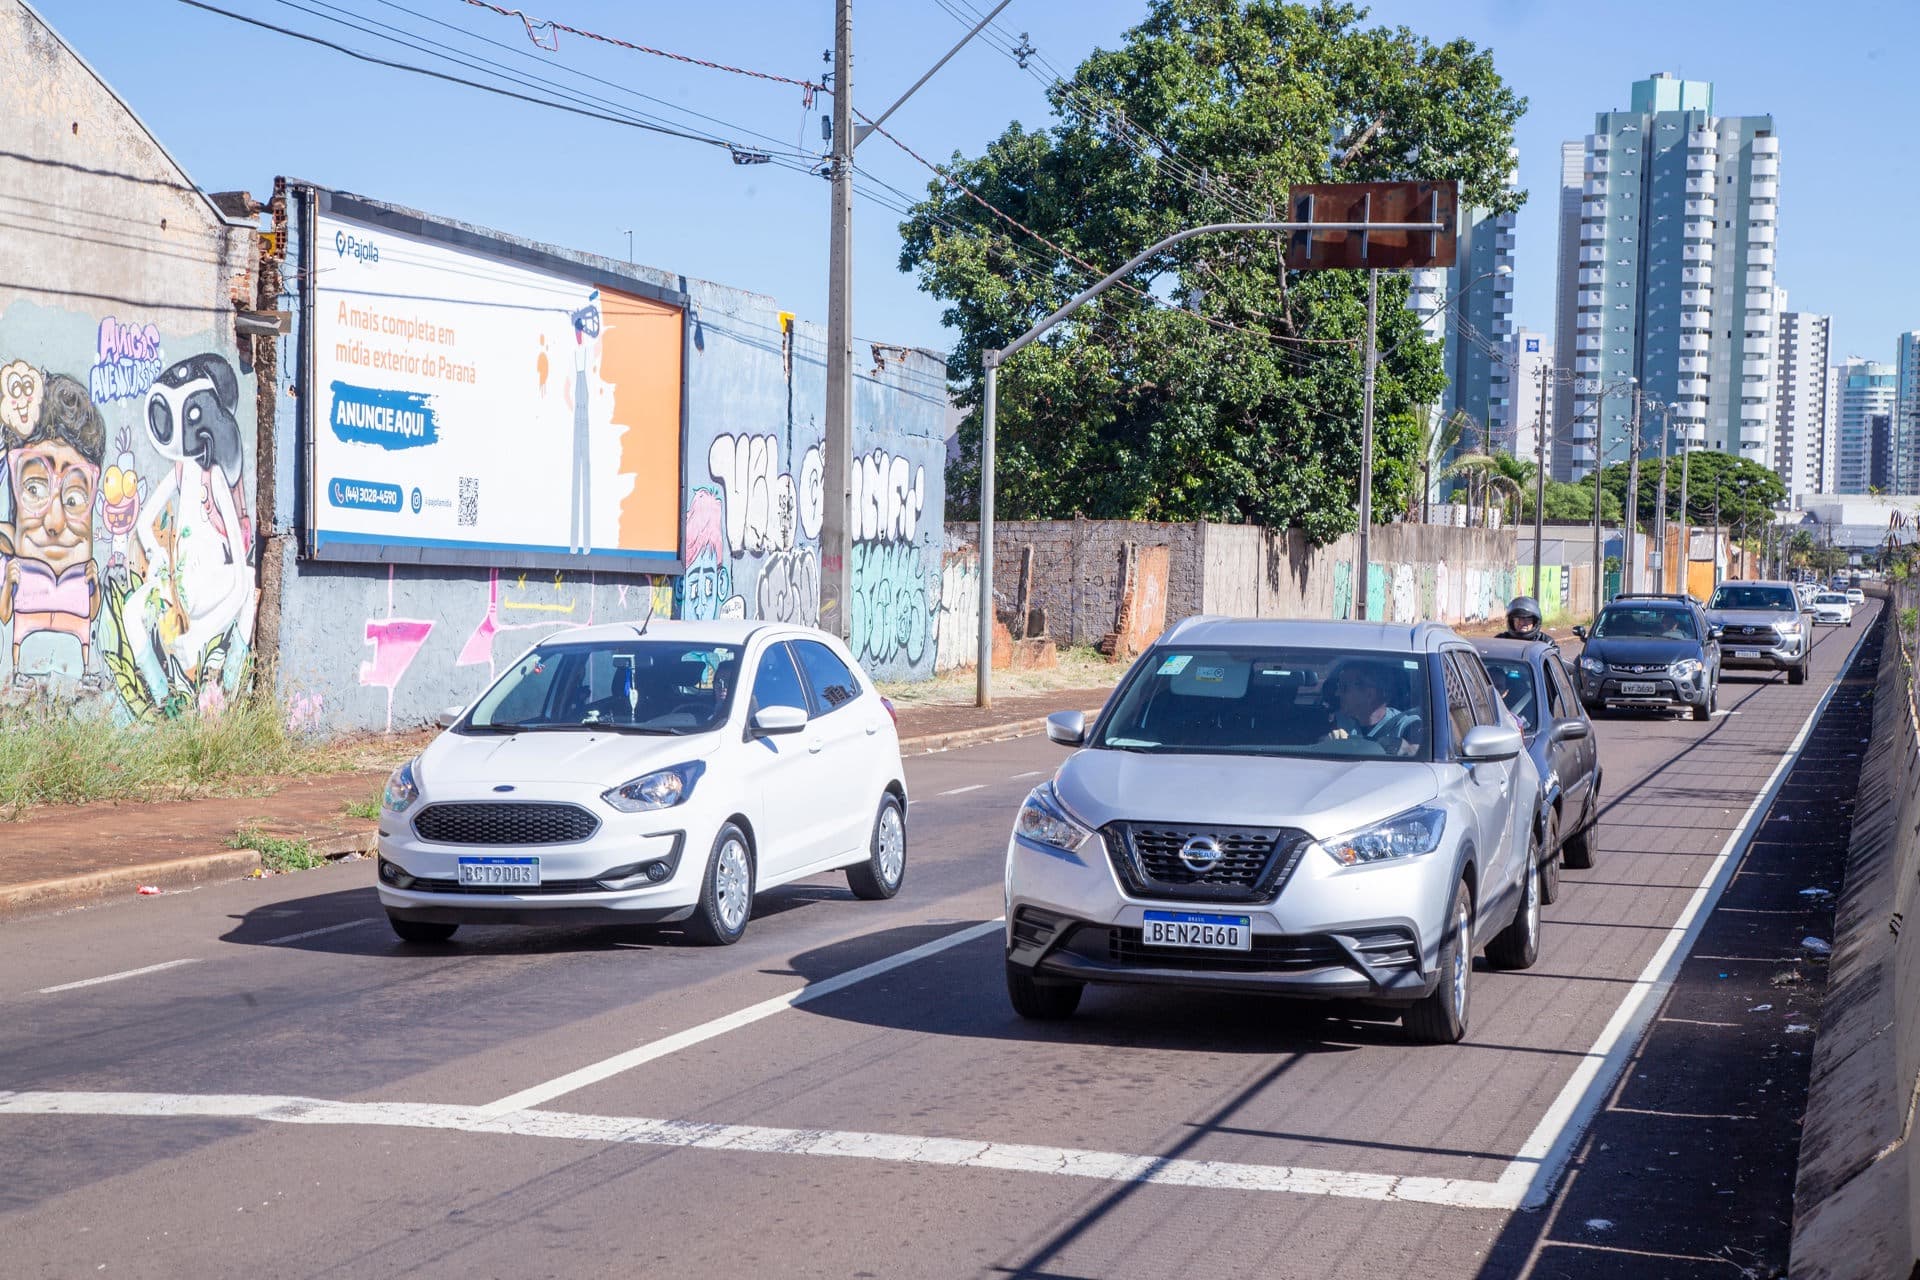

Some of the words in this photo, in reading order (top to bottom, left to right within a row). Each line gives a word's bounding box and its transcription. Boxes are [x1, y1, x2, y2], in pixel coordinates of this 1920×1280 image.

[347, 236, 379, 264] Pajolla
[338, 301, 348, 326] A
[350, 306, 379, 332] mais
[382, 315, 436, 343] completa
[438, 326, 455, 346] em
[373, 349, 420, 374] exterior
[422, 353, 435, 377] do
[438, 355, 476, 384] Paraná
[336, 400, 394, 433] ANUNCIE
[394, 410, 425, 438] AQUI
[345, 486, 359, 504] (44)
[359, 489, 397, 505] 3028-4590
[1153, 923, 1238, 945] BEN2G60
